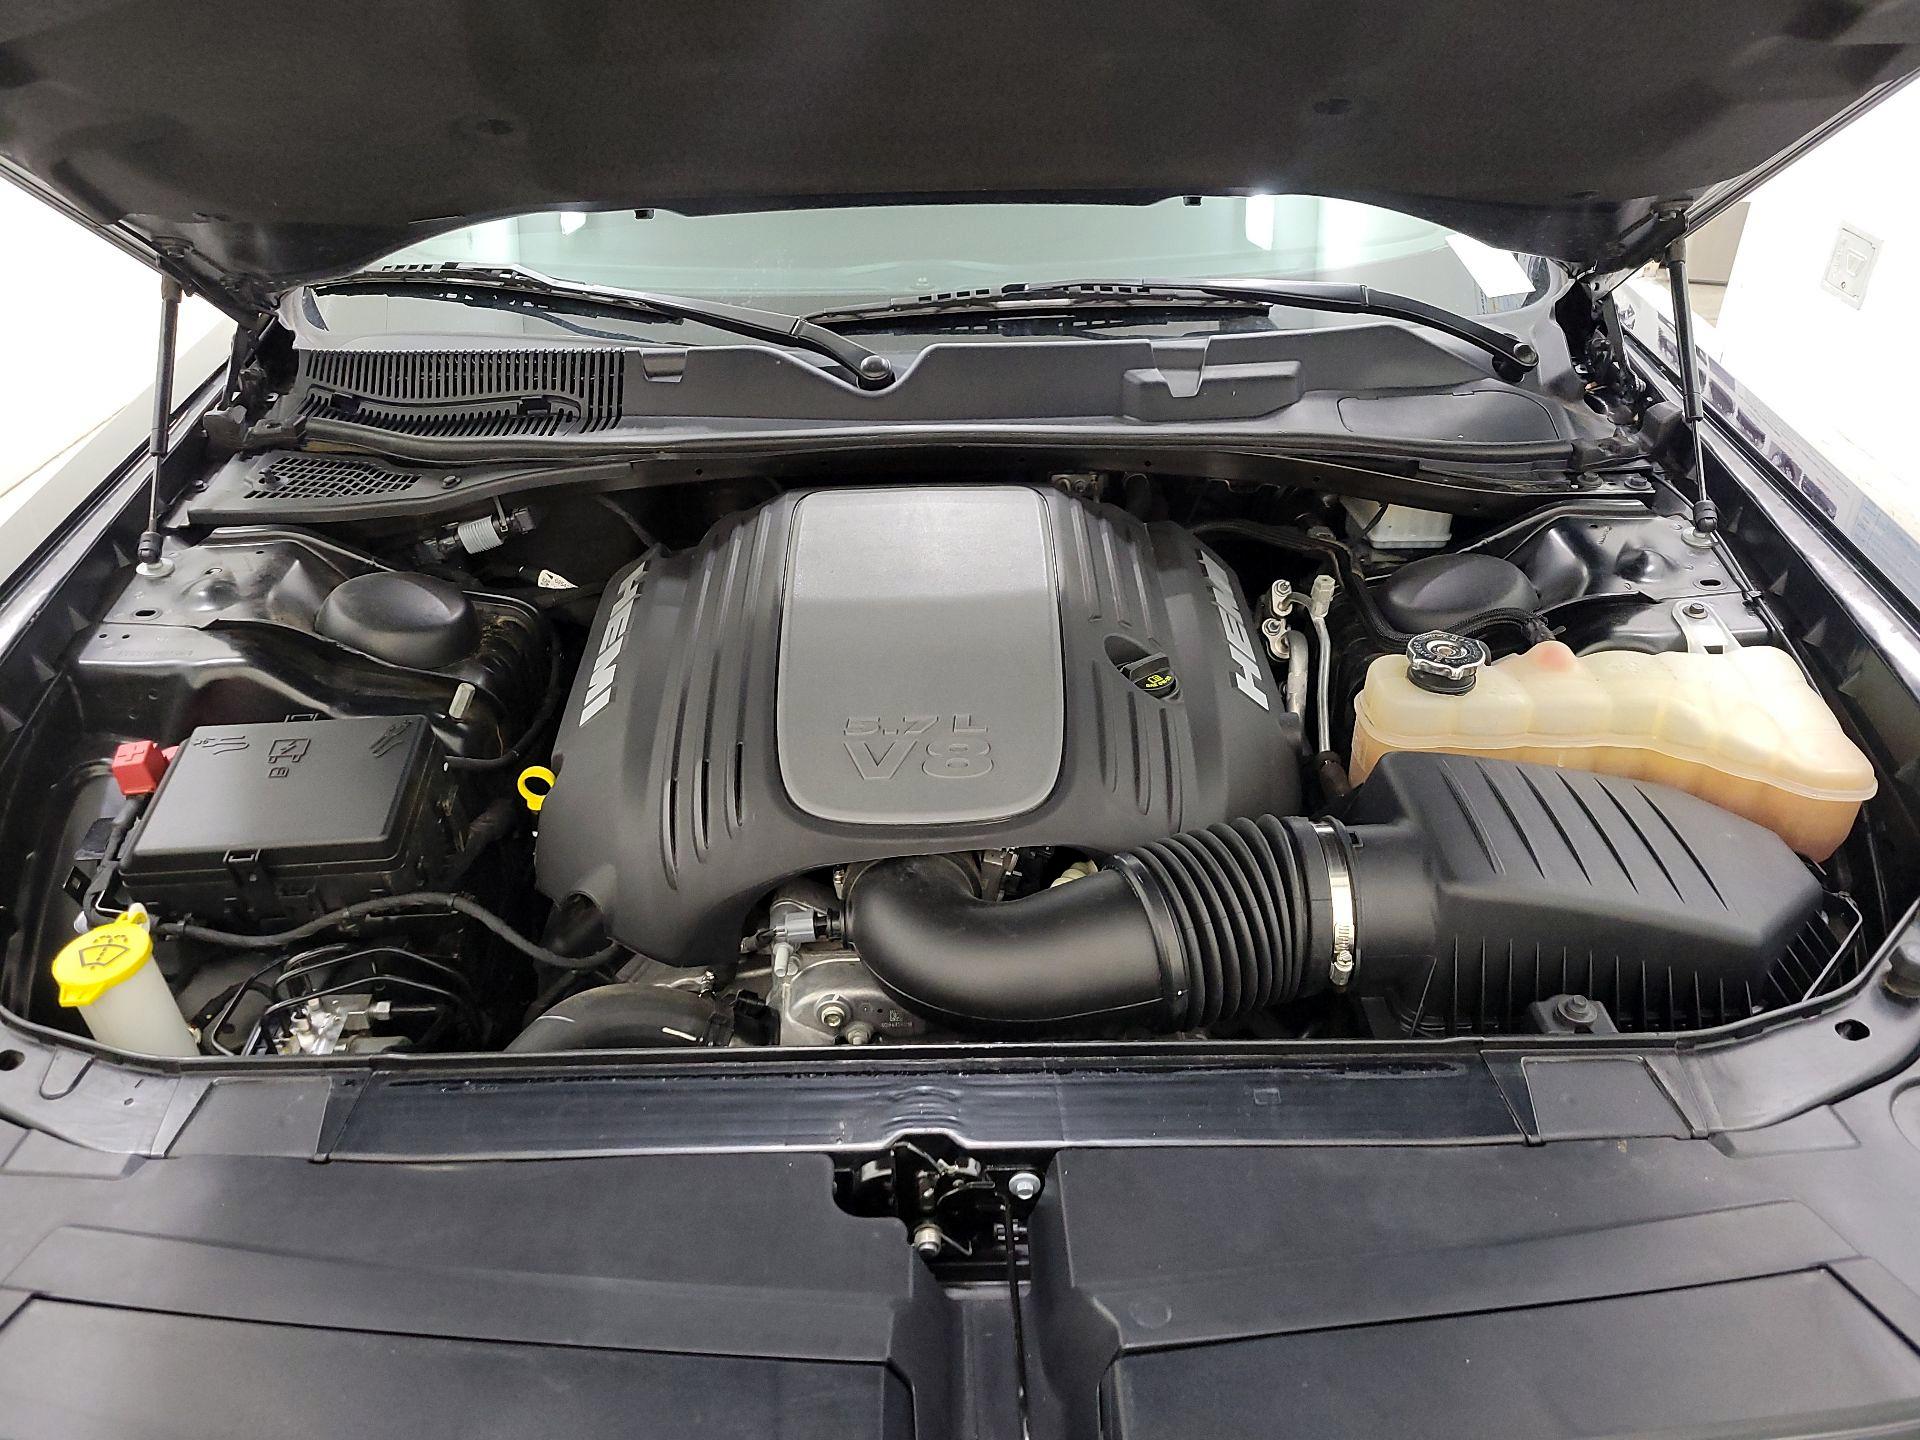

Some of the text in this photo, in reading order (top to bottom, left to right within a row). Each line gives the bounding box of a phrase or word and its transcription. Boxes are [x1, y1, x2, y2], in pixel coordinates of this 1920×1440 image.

[579, 561, 647, 727] HEMI
[1200, 550, 1270, 711] HEMI
[843, 738, 995, 781] V8
